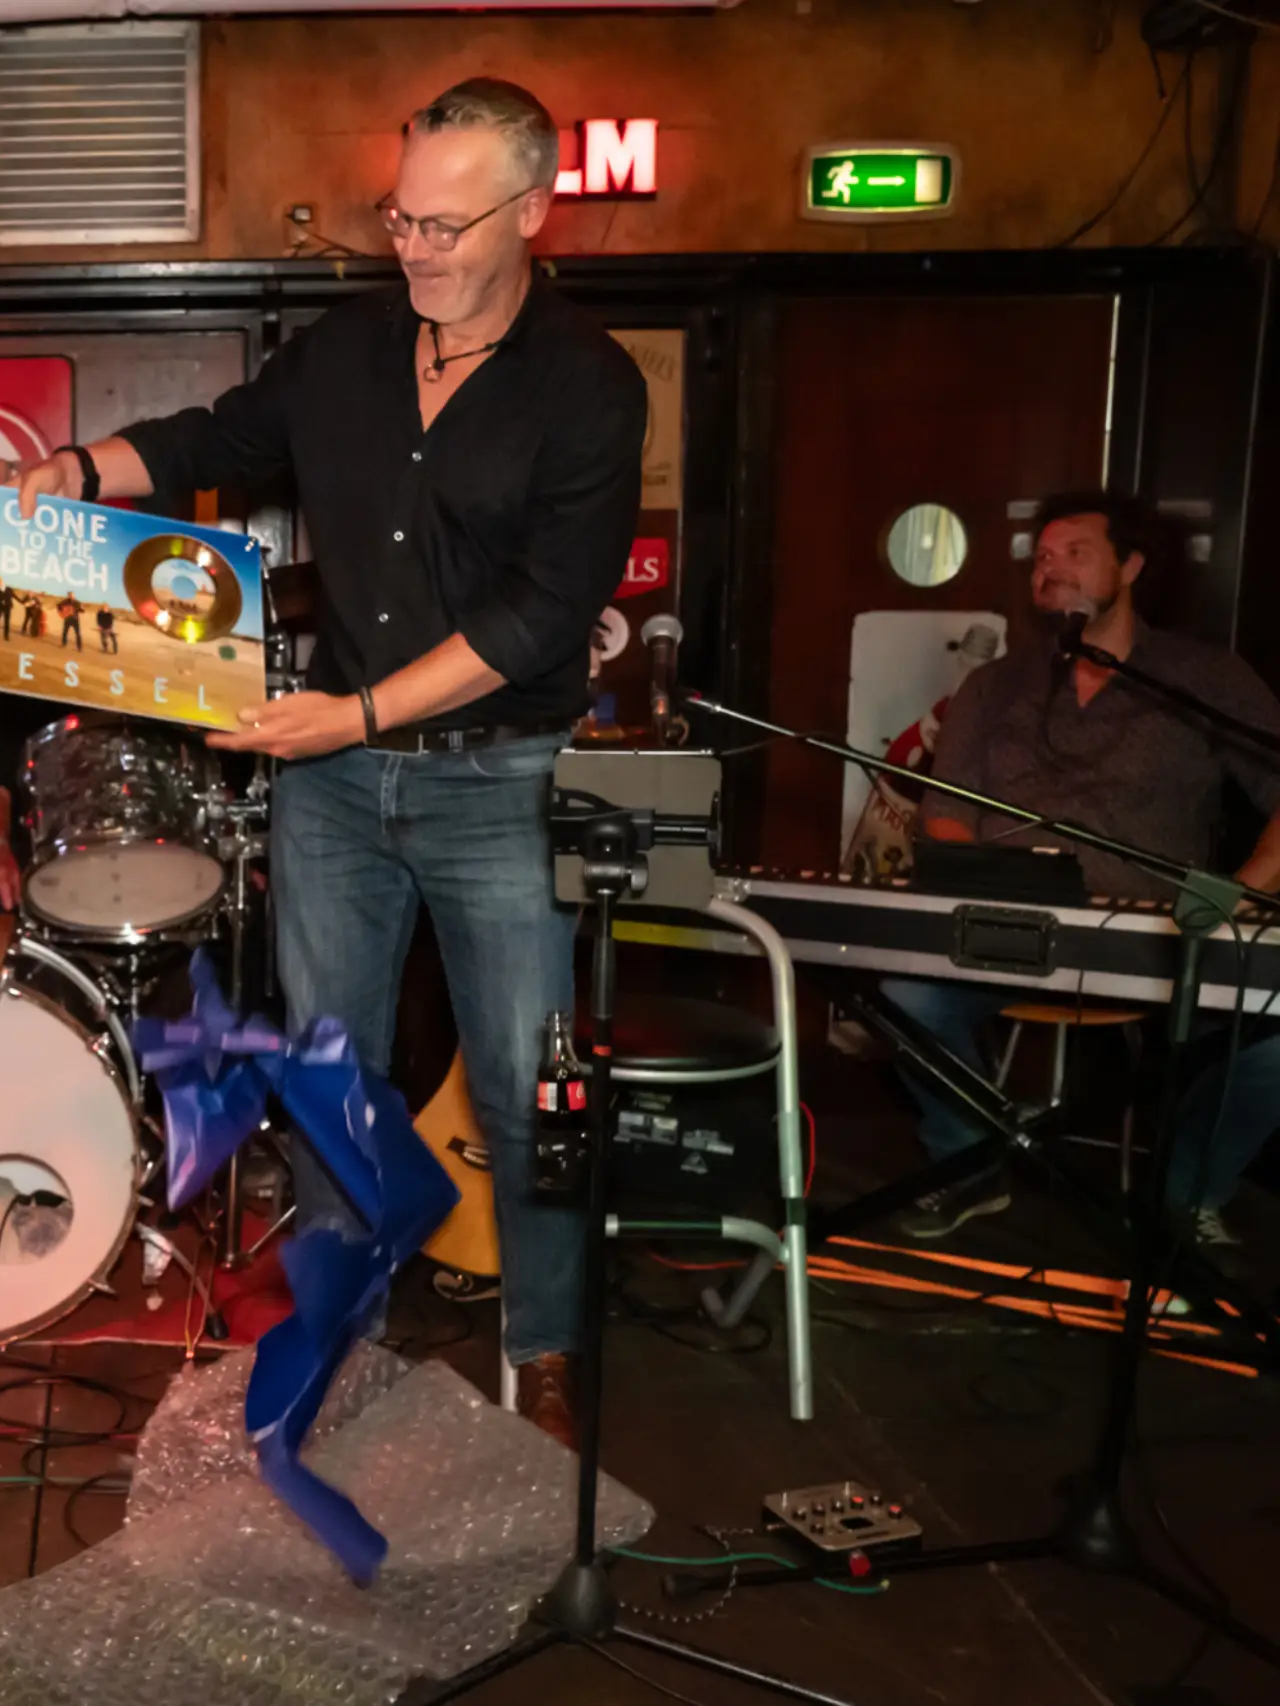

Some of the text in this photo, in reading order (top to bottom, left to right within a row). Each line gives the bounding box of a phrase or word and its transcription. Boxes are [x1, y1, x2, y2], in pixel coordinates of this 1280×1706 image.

[19, 527, 93, 561] TO THE
[1, 544, 109, 593] BEACH
[623, 557, 660, 583] LS
